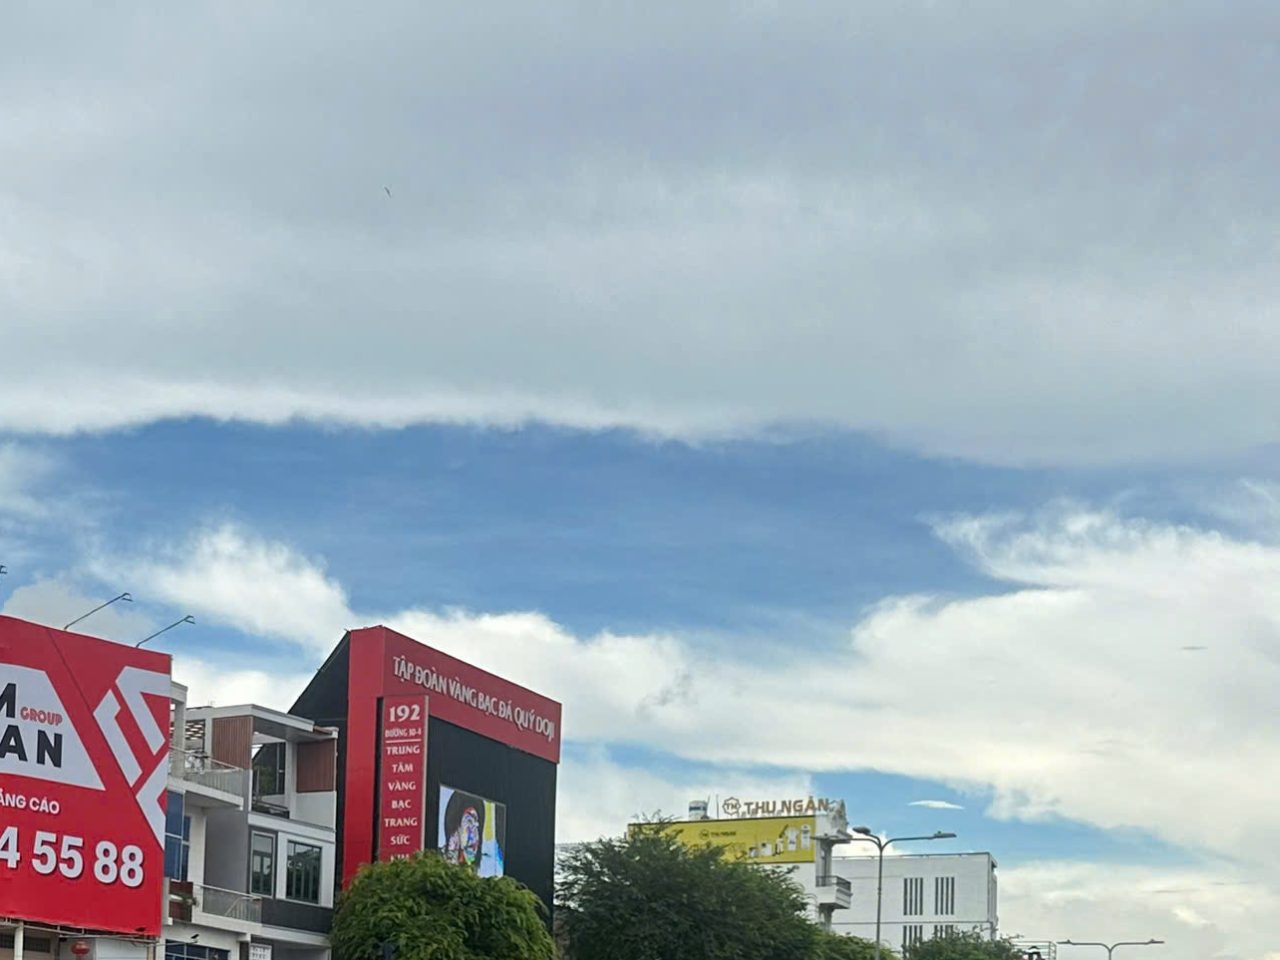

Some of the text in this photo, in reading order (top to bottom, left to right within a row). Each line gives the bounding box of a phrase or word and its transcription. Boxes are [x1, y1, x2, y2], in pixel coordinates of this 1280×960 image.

[393, 655, 555, 743] TẬP ĐOÀN VÀNG BẠC ĐÁ QUÝ DOJI
[20, 707, 63, 726] GROUP
[389, 704, 421, 722] 192
[386, 745, 420, 756] TRUNG
[392, 761, 413, 773] TÂM
[388, 780, 416, 792] VÀNG
[29, 797, 60, 815] CÁO
[391, 799, 412, 811] BẠC
[744, 796, 829, 816] THU NGÂN
[384, 818, 418, 828] TRANG
[390, 834, 411, 846] SỨC
[31, 830, 84, 879] 55
[93, 840, 144, 887] 88
